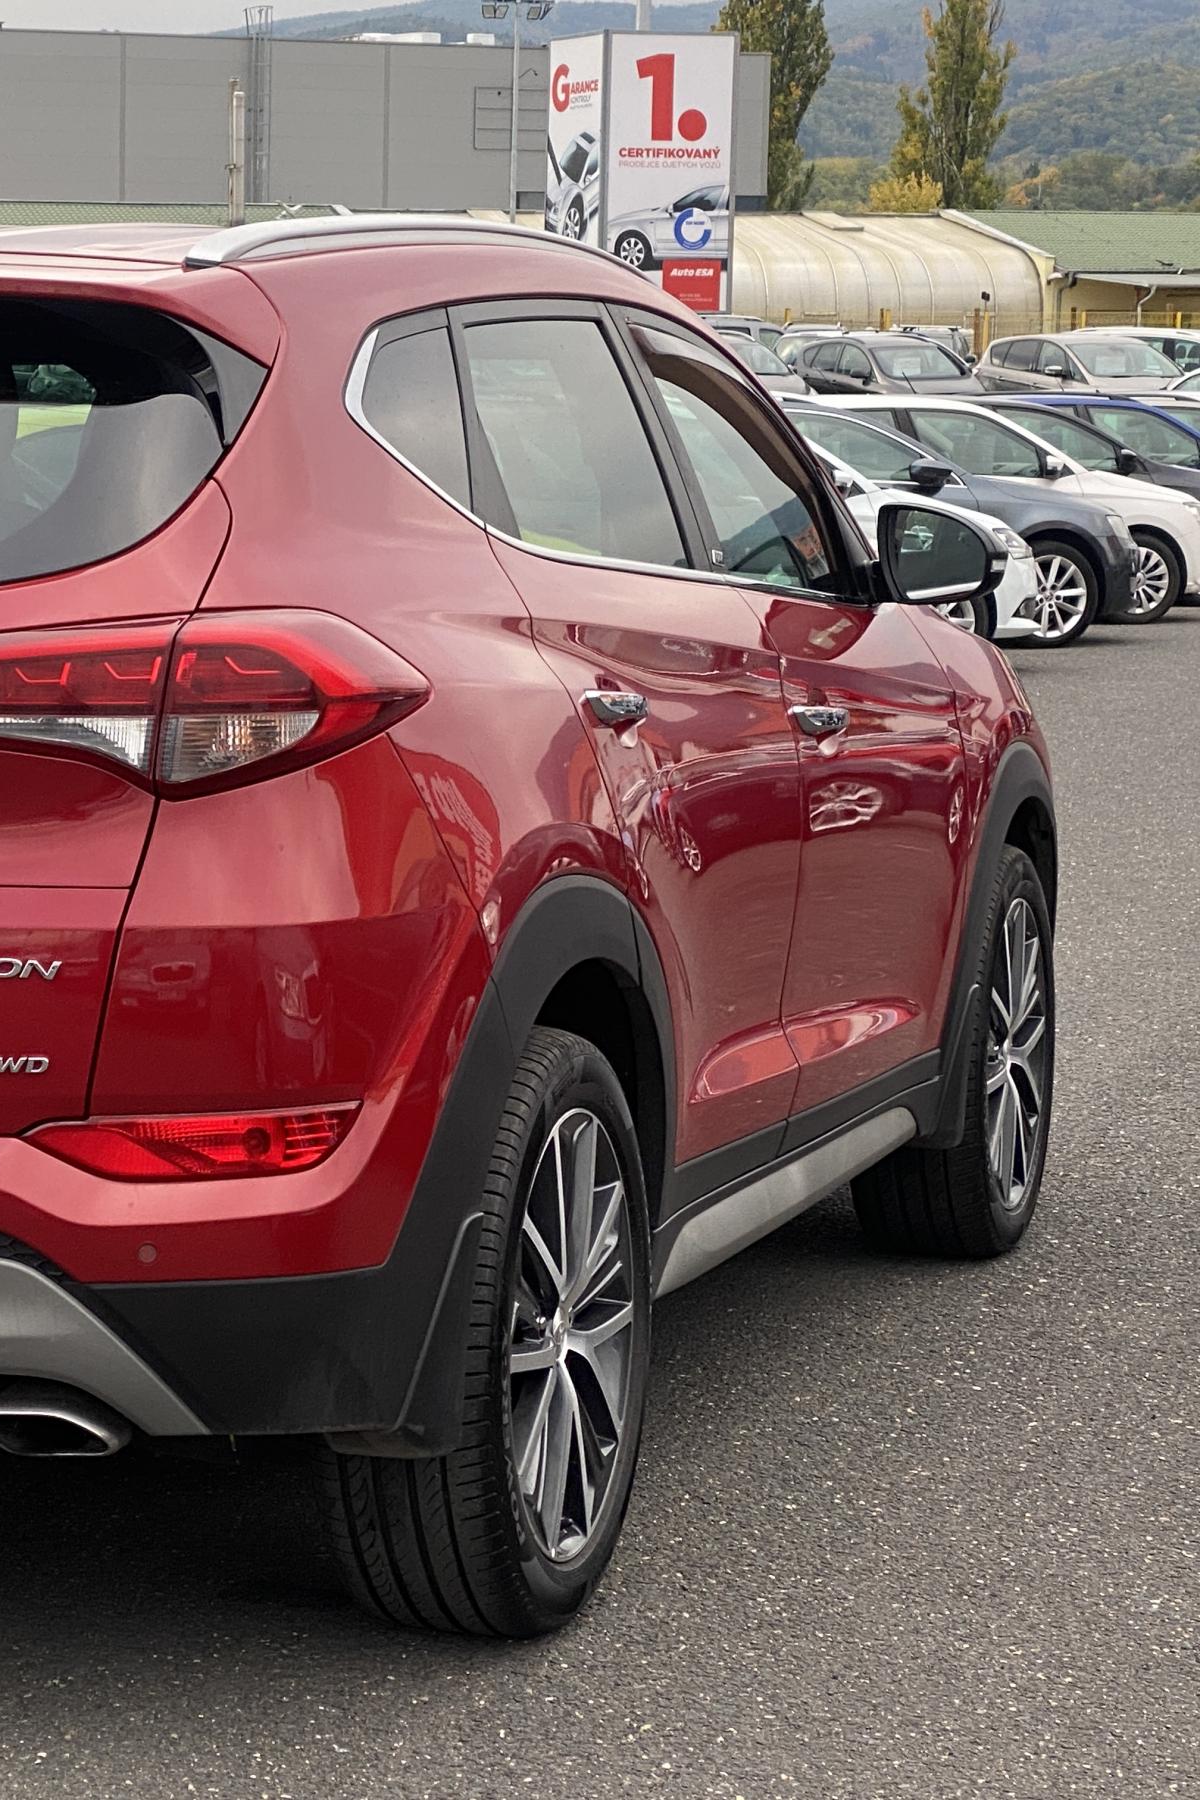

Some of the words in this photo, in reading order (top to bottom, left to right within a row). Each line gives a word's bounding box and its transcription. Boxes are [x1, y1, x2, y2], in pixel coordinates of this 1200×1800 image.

[552, 63, 599, 112] GARANCE
[636, 53, 707, 141] 1.
[618, 146, 721, 159] CERTIFIKOVANÝ
[618, 160, 660, 169] PRODEJCE
[670, 268, 695, 277] Auto
[695, 268, 715, 277] ESA
